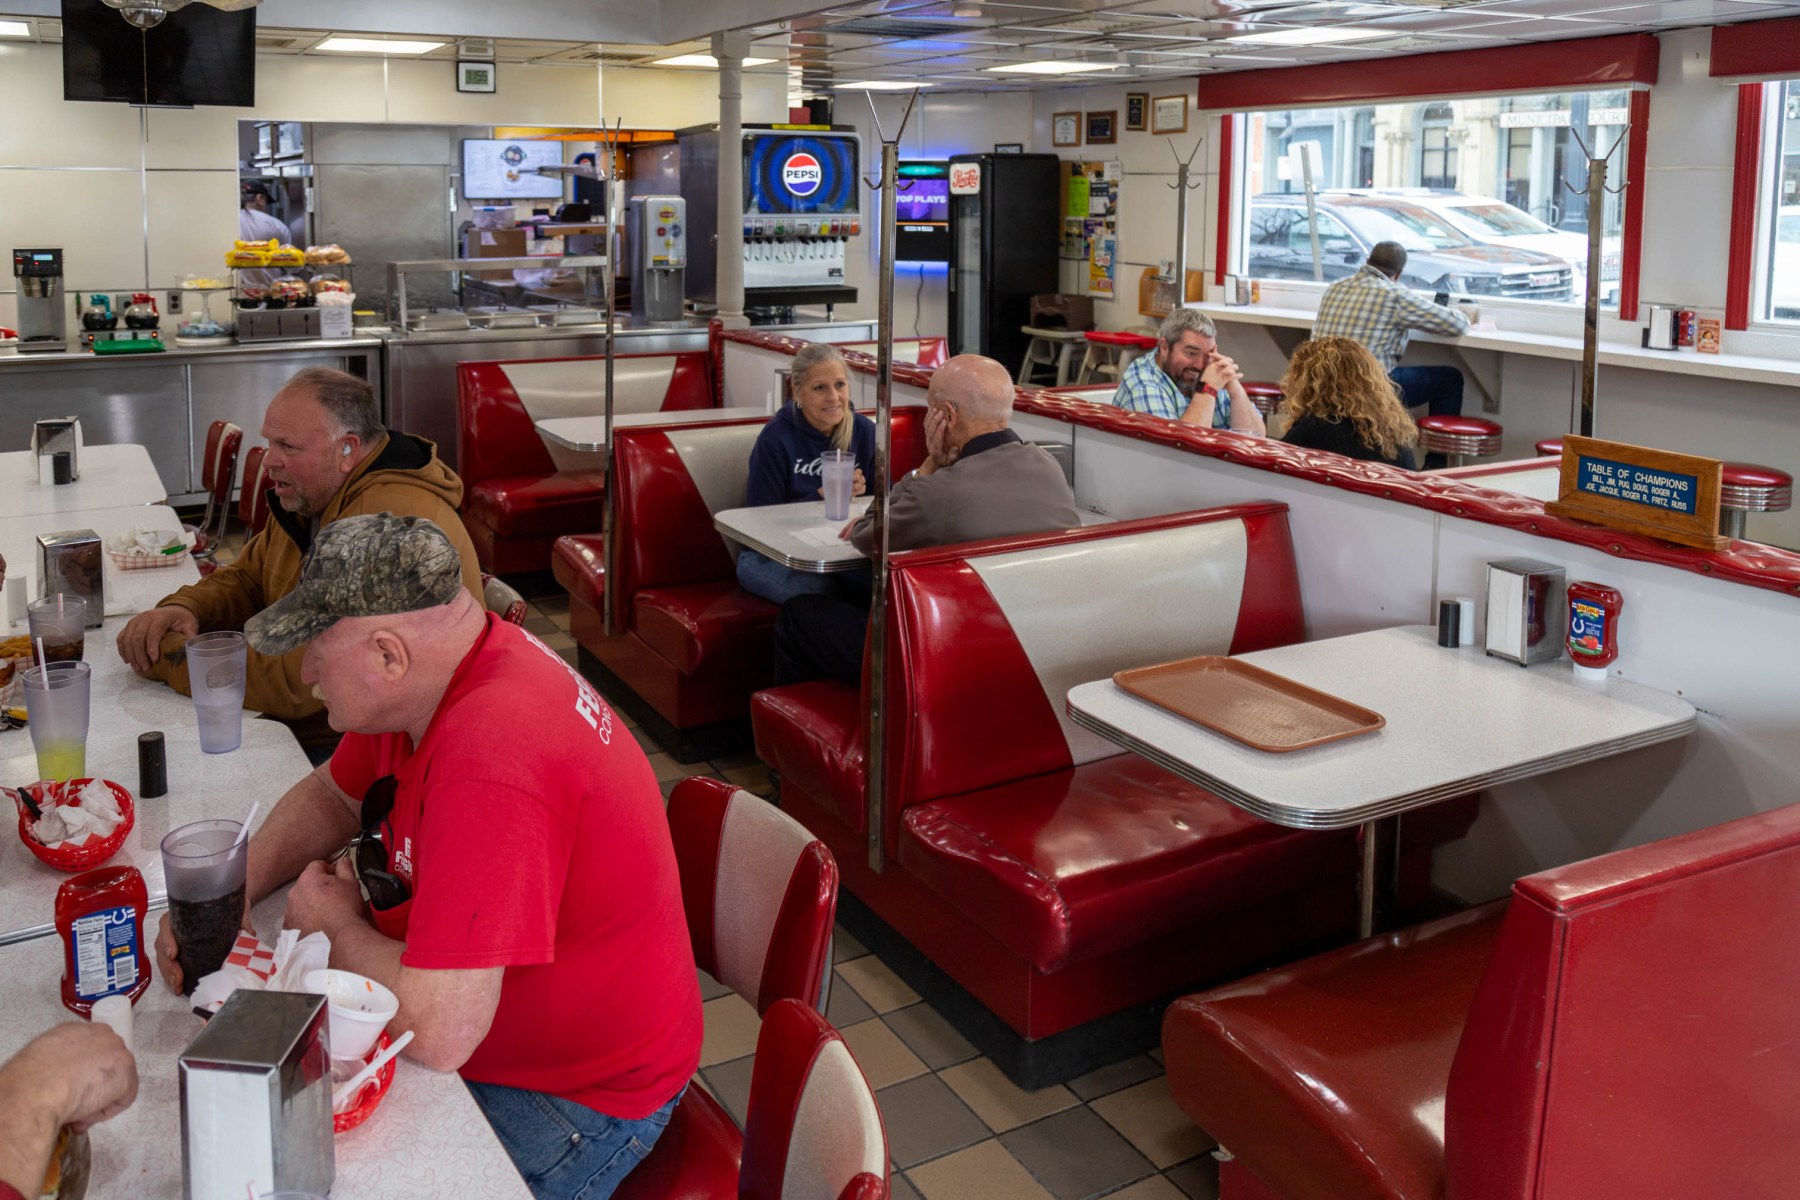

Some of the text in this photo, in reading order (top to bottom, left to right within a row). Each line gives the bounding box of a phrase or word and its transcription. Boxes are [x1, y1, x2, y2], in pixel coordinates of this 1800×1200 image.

[1506, 110, 1627, 126] MUNICIPA OURT
[786, 170, 819, 179] PEPSI
[896, 195, 947, 204] TOP PLAYS
[1586, 462, 1689, 491] TABLE OF CHAMPIONS
[1632, 482, 1649, 494] DOUG,
[1651, 486, 1671, 497] ROGER
[1621, 490, 1641, 500] ROGER
[1671, 500, 1687, 511] RUSS
